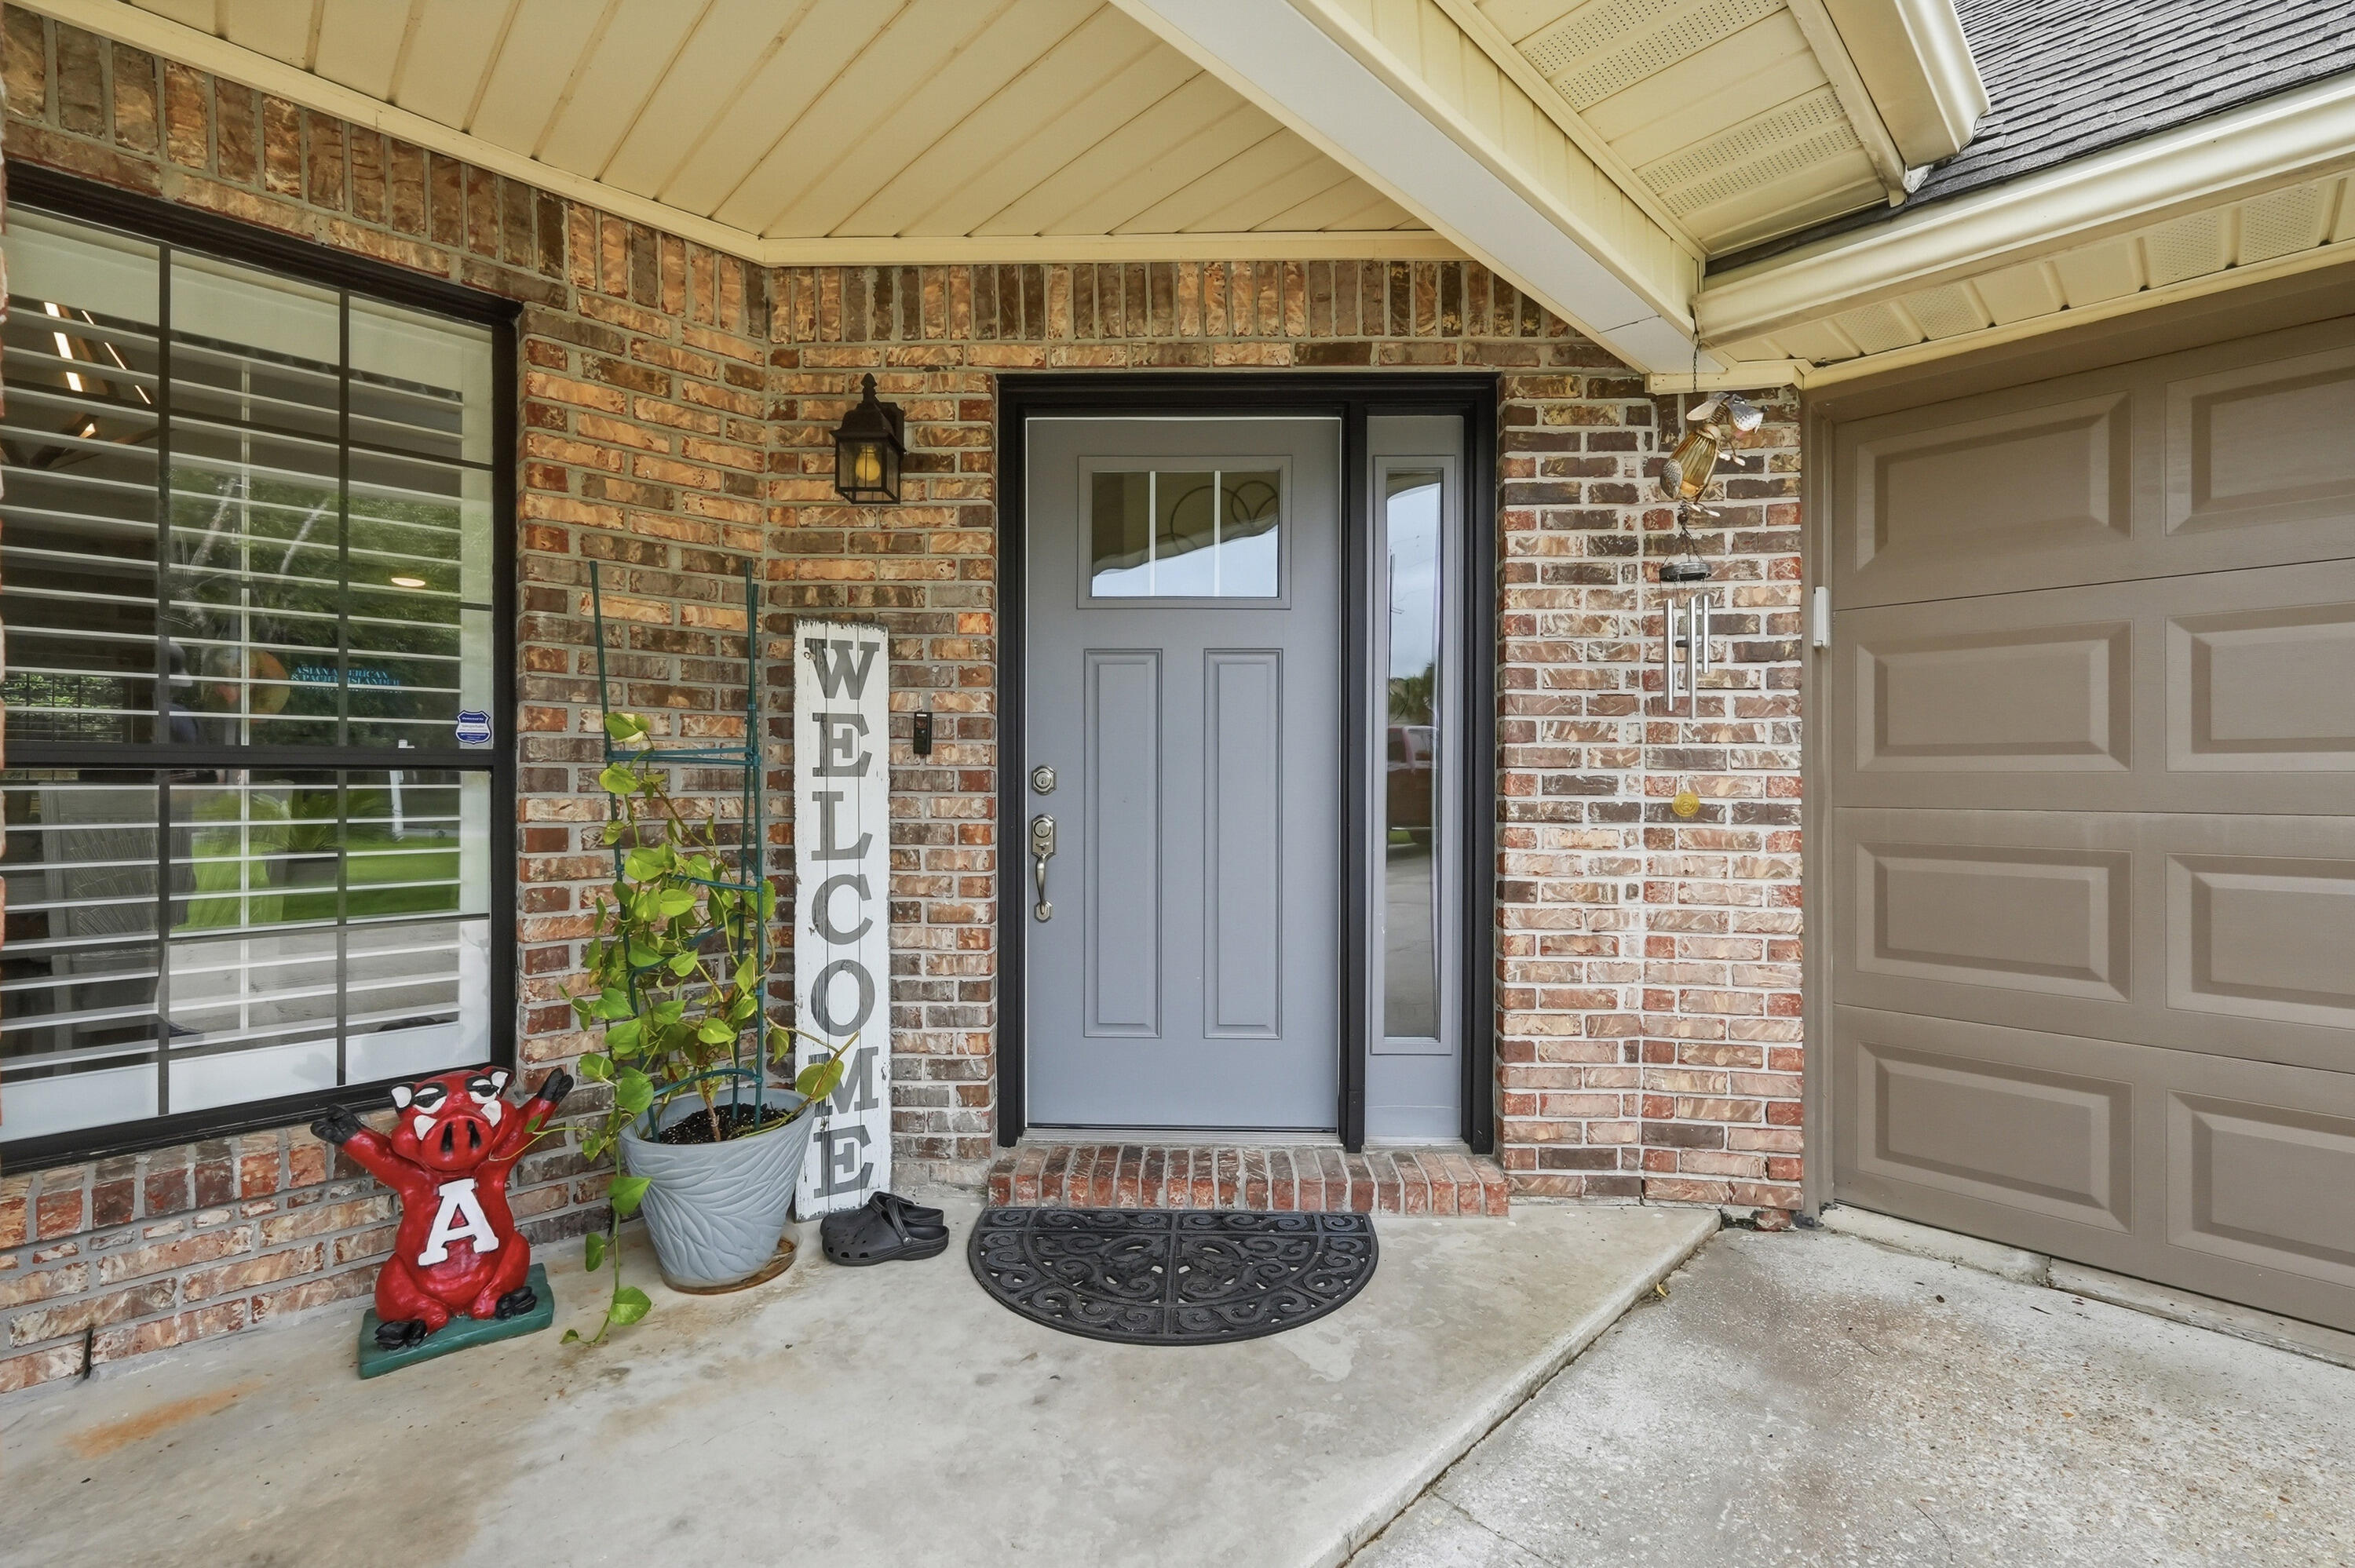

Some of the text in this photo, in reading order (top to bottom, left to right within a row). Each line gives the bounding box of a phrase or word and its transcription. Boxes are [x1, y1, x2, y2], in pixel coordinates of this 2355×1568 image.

[295, 666, 389, 679] ASIAN AERICAN
[804, 637, 881, 1199] WELCOME
[418, 1178, 499, 1267] A
